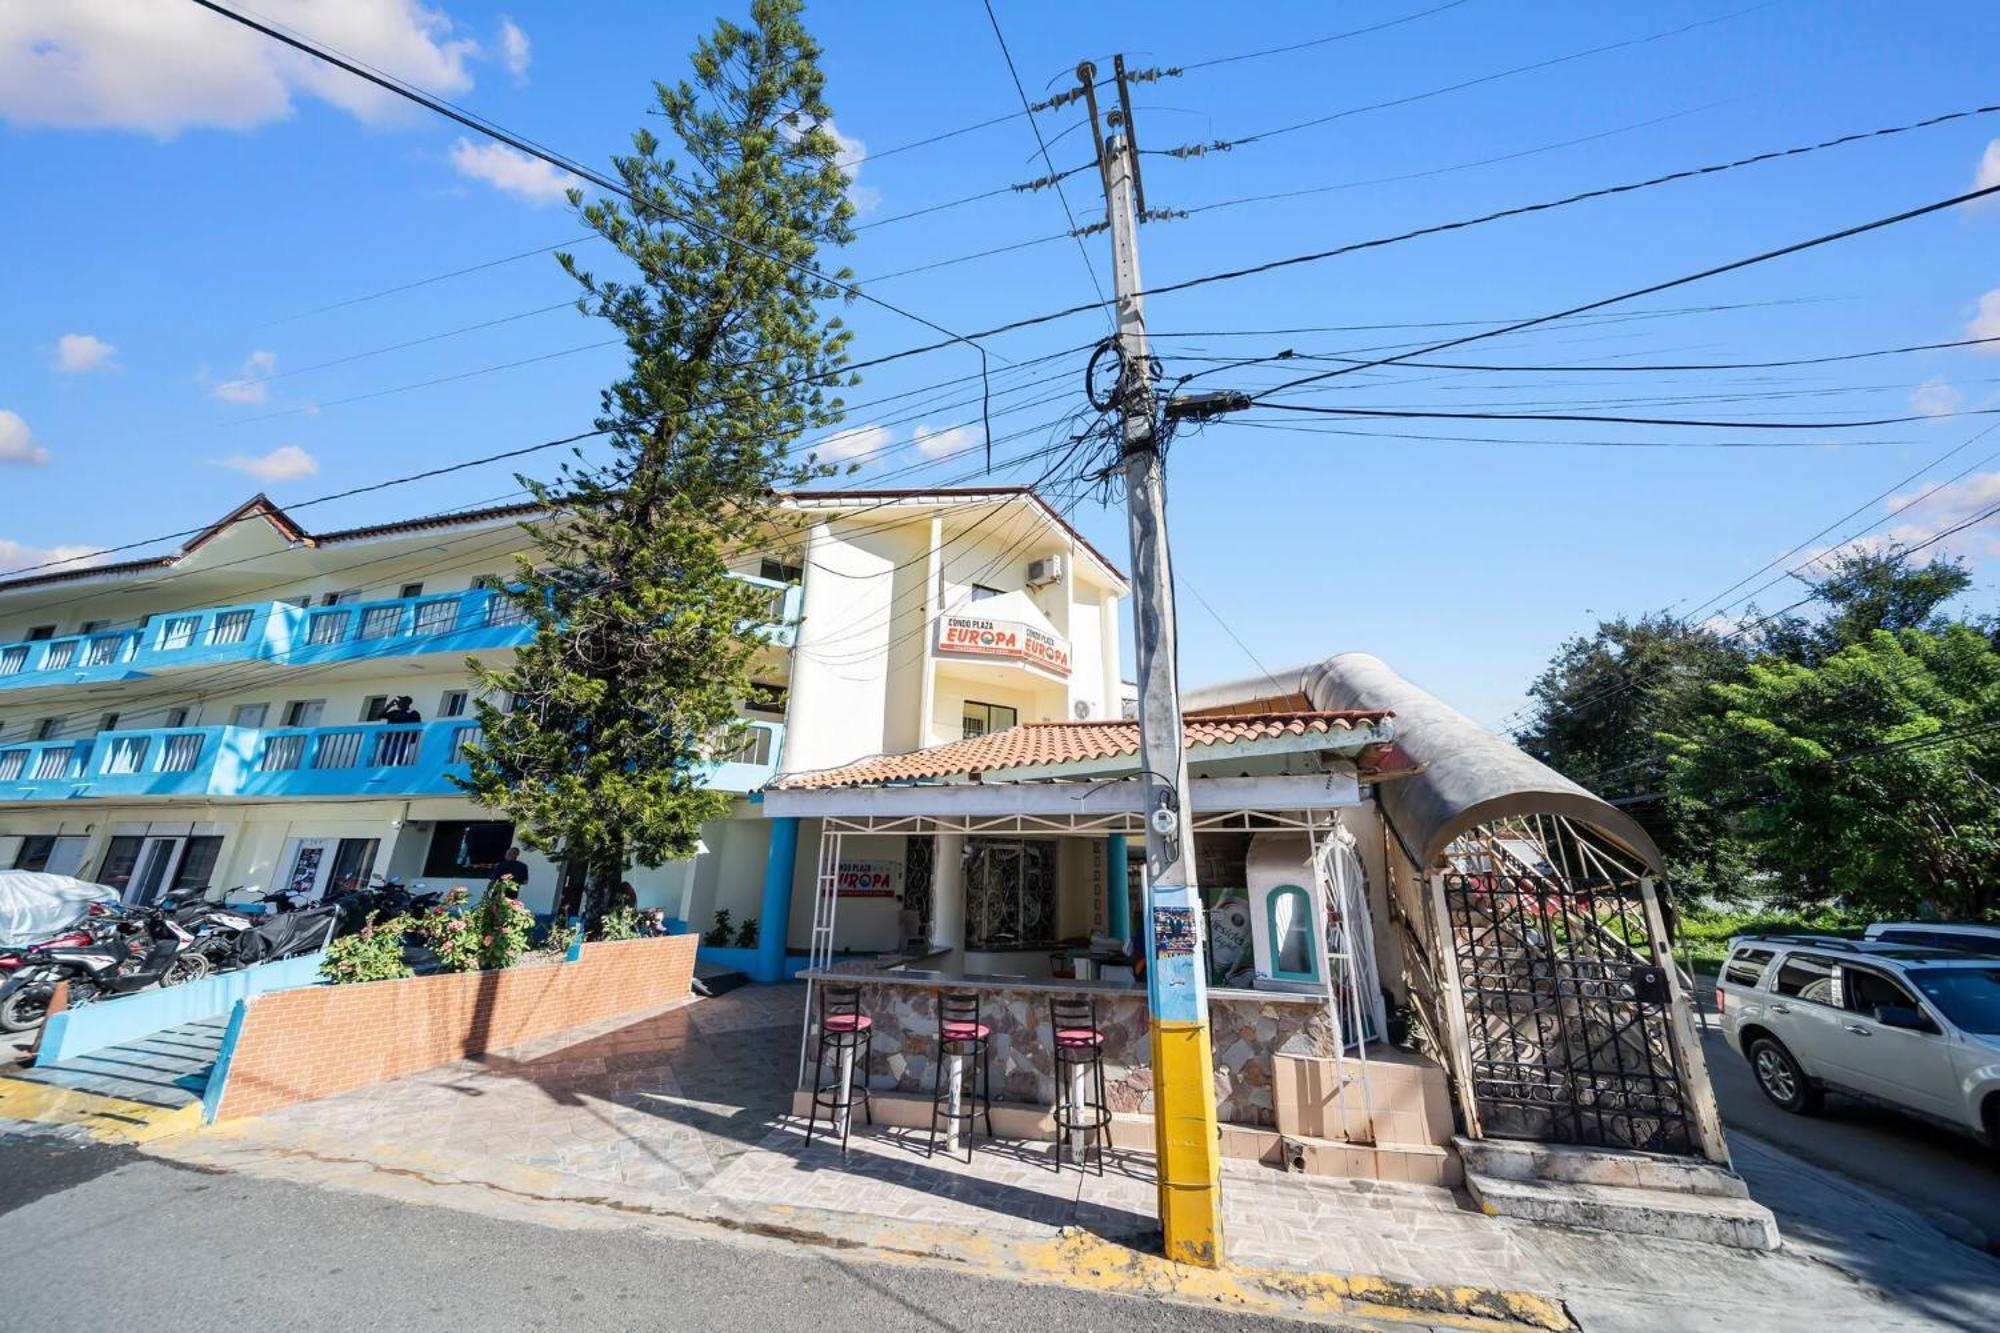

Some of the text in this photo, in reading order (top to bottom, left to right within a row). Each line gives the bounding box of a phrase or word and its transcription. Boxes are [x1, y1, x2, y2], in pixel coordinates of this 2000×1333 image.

[948, 618, 994, 630] CONDO PLAZA
[947, 627, 1016, 647] EUROPA
[1025, 639, 1068, 666] EUROPA
